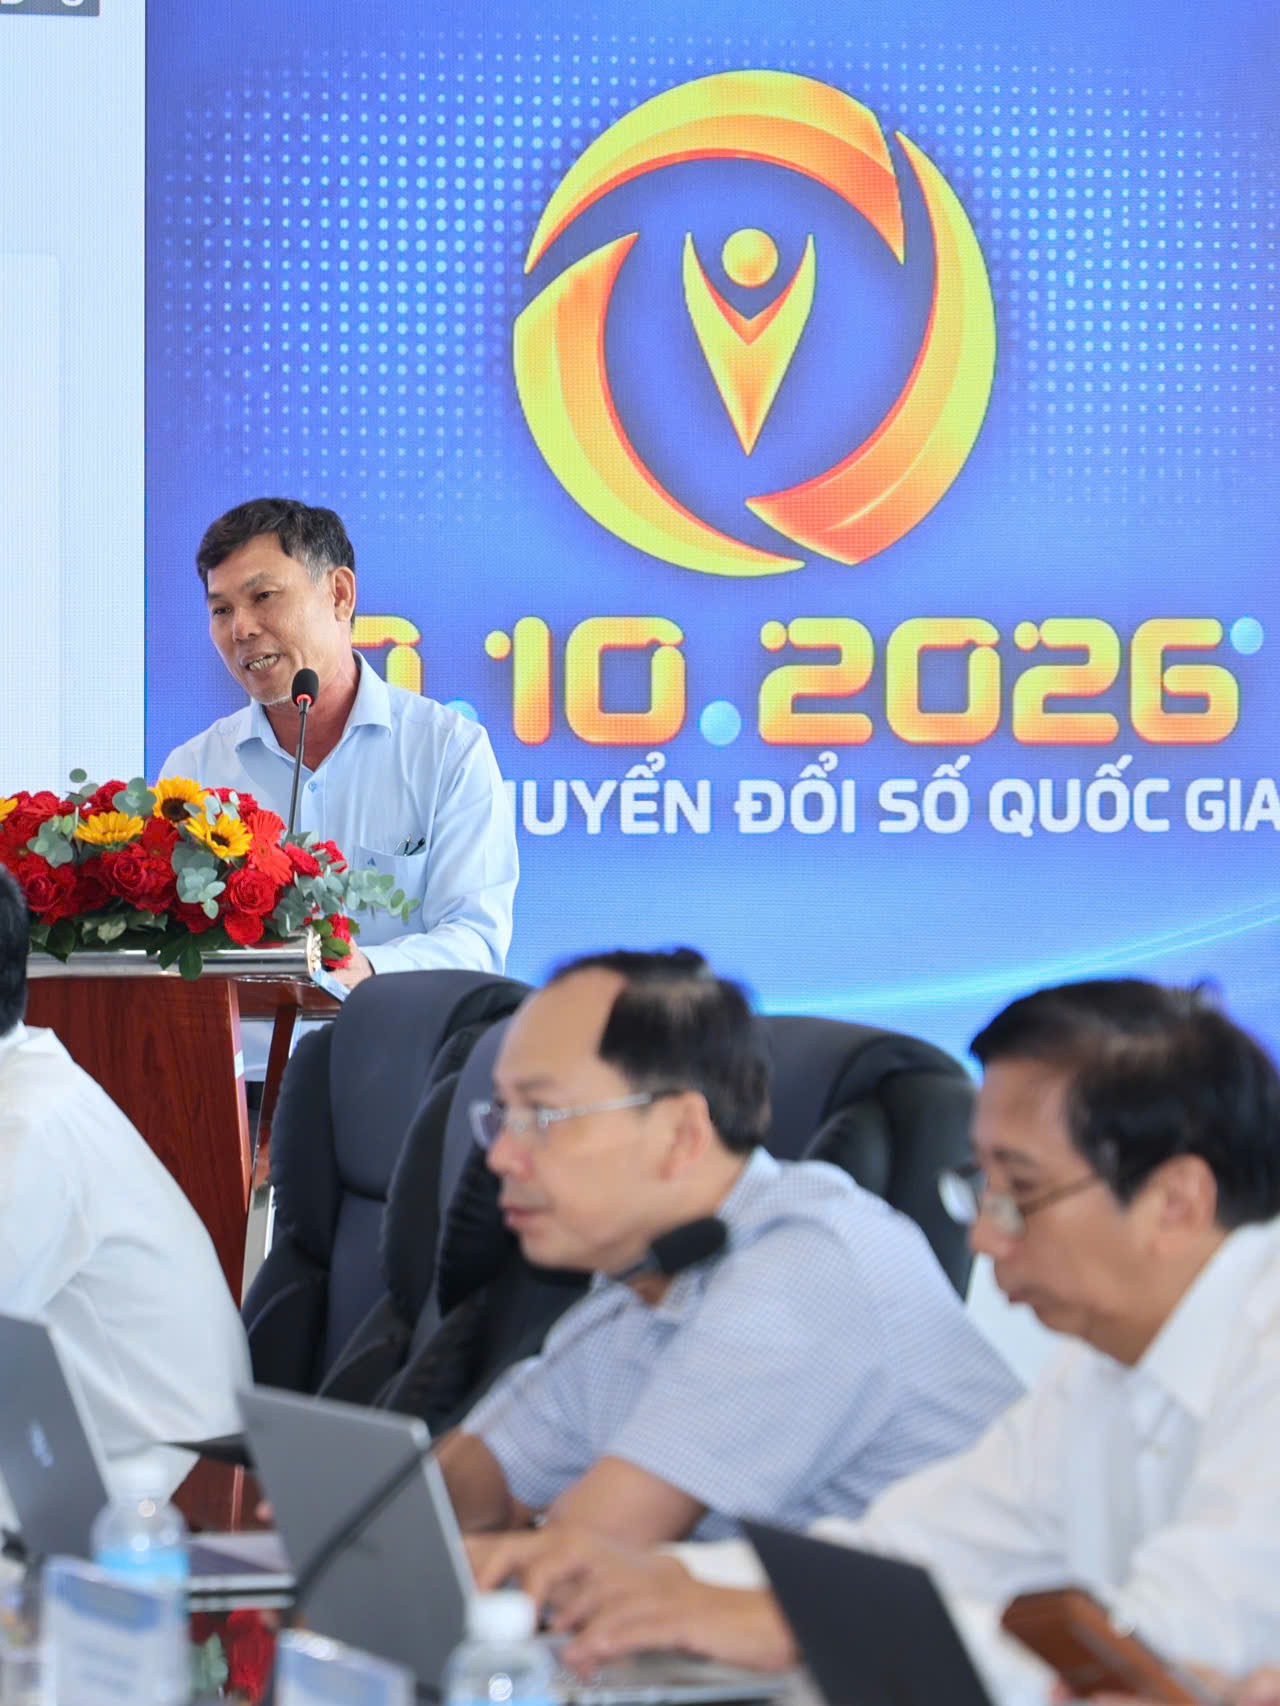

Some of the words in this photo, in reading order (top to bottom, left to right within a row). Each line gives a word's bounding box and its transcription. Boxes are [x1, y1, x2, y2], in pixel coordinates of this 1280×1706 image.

[504, 751, 712, 837] UYỂN
[735, 750, 856, 833] ĐỔI
[880, 752, 970, 833] SỐ
[990, 752, 1170, 835] QUỐC
[1185, 778, 1280, 833] GIA
